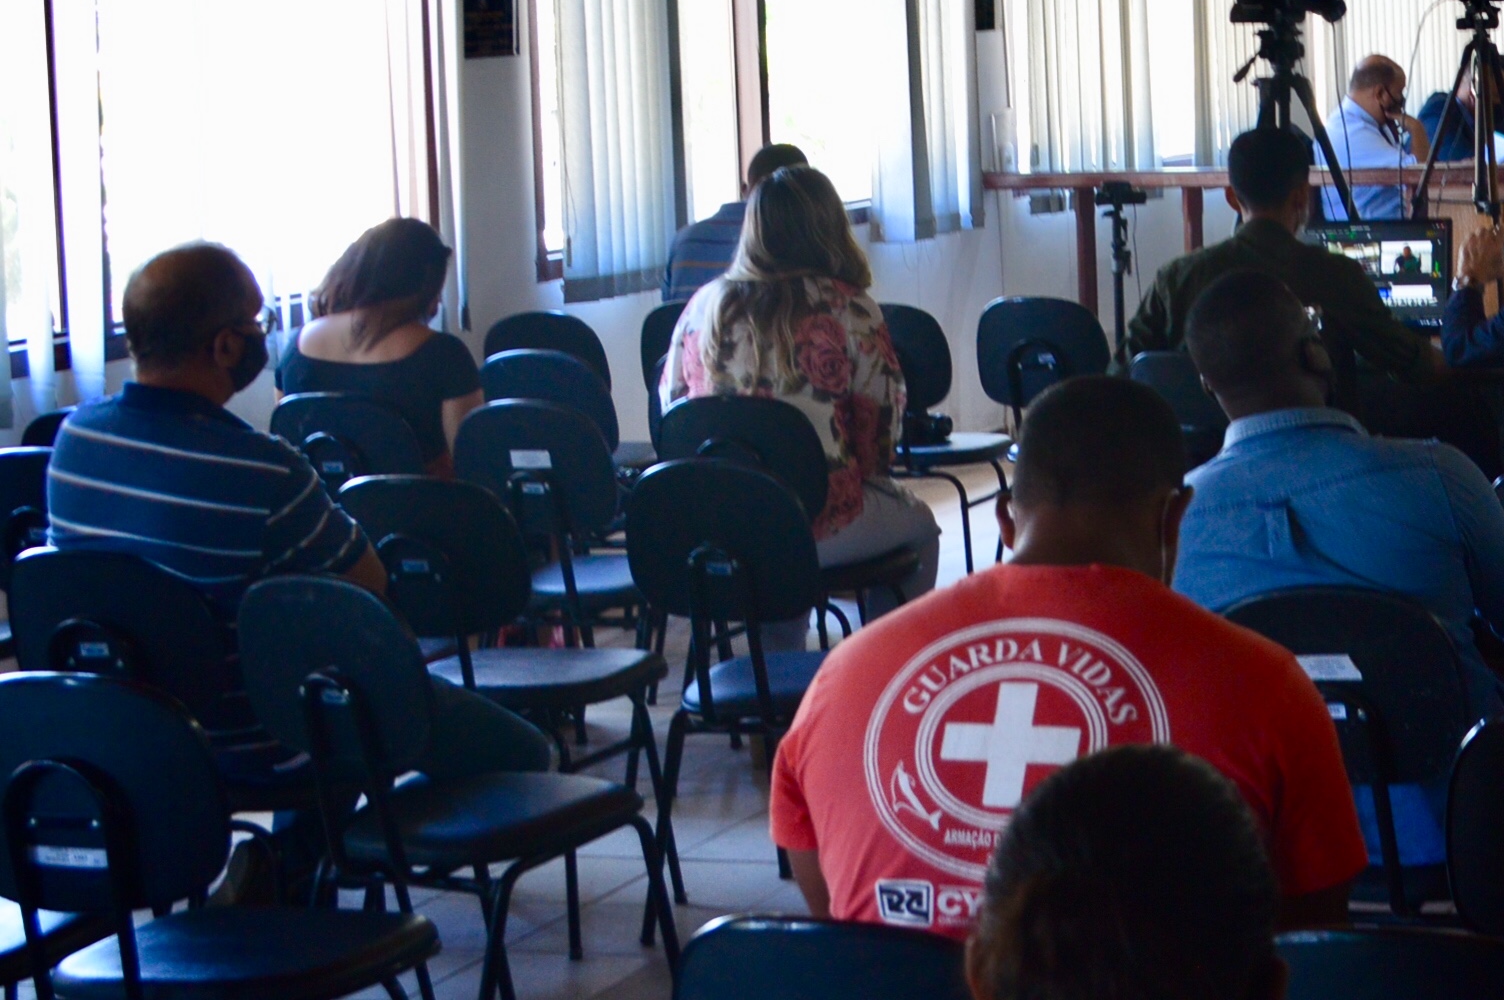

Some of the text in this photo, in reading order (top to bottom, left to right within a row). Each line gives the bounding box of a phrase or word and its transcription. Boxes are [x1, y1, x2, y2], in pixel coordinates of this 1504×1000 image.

[903, 637, 1138, 726] GUARDA VIDAS
[944, 828, 991, 850] ARMAÇÃO
